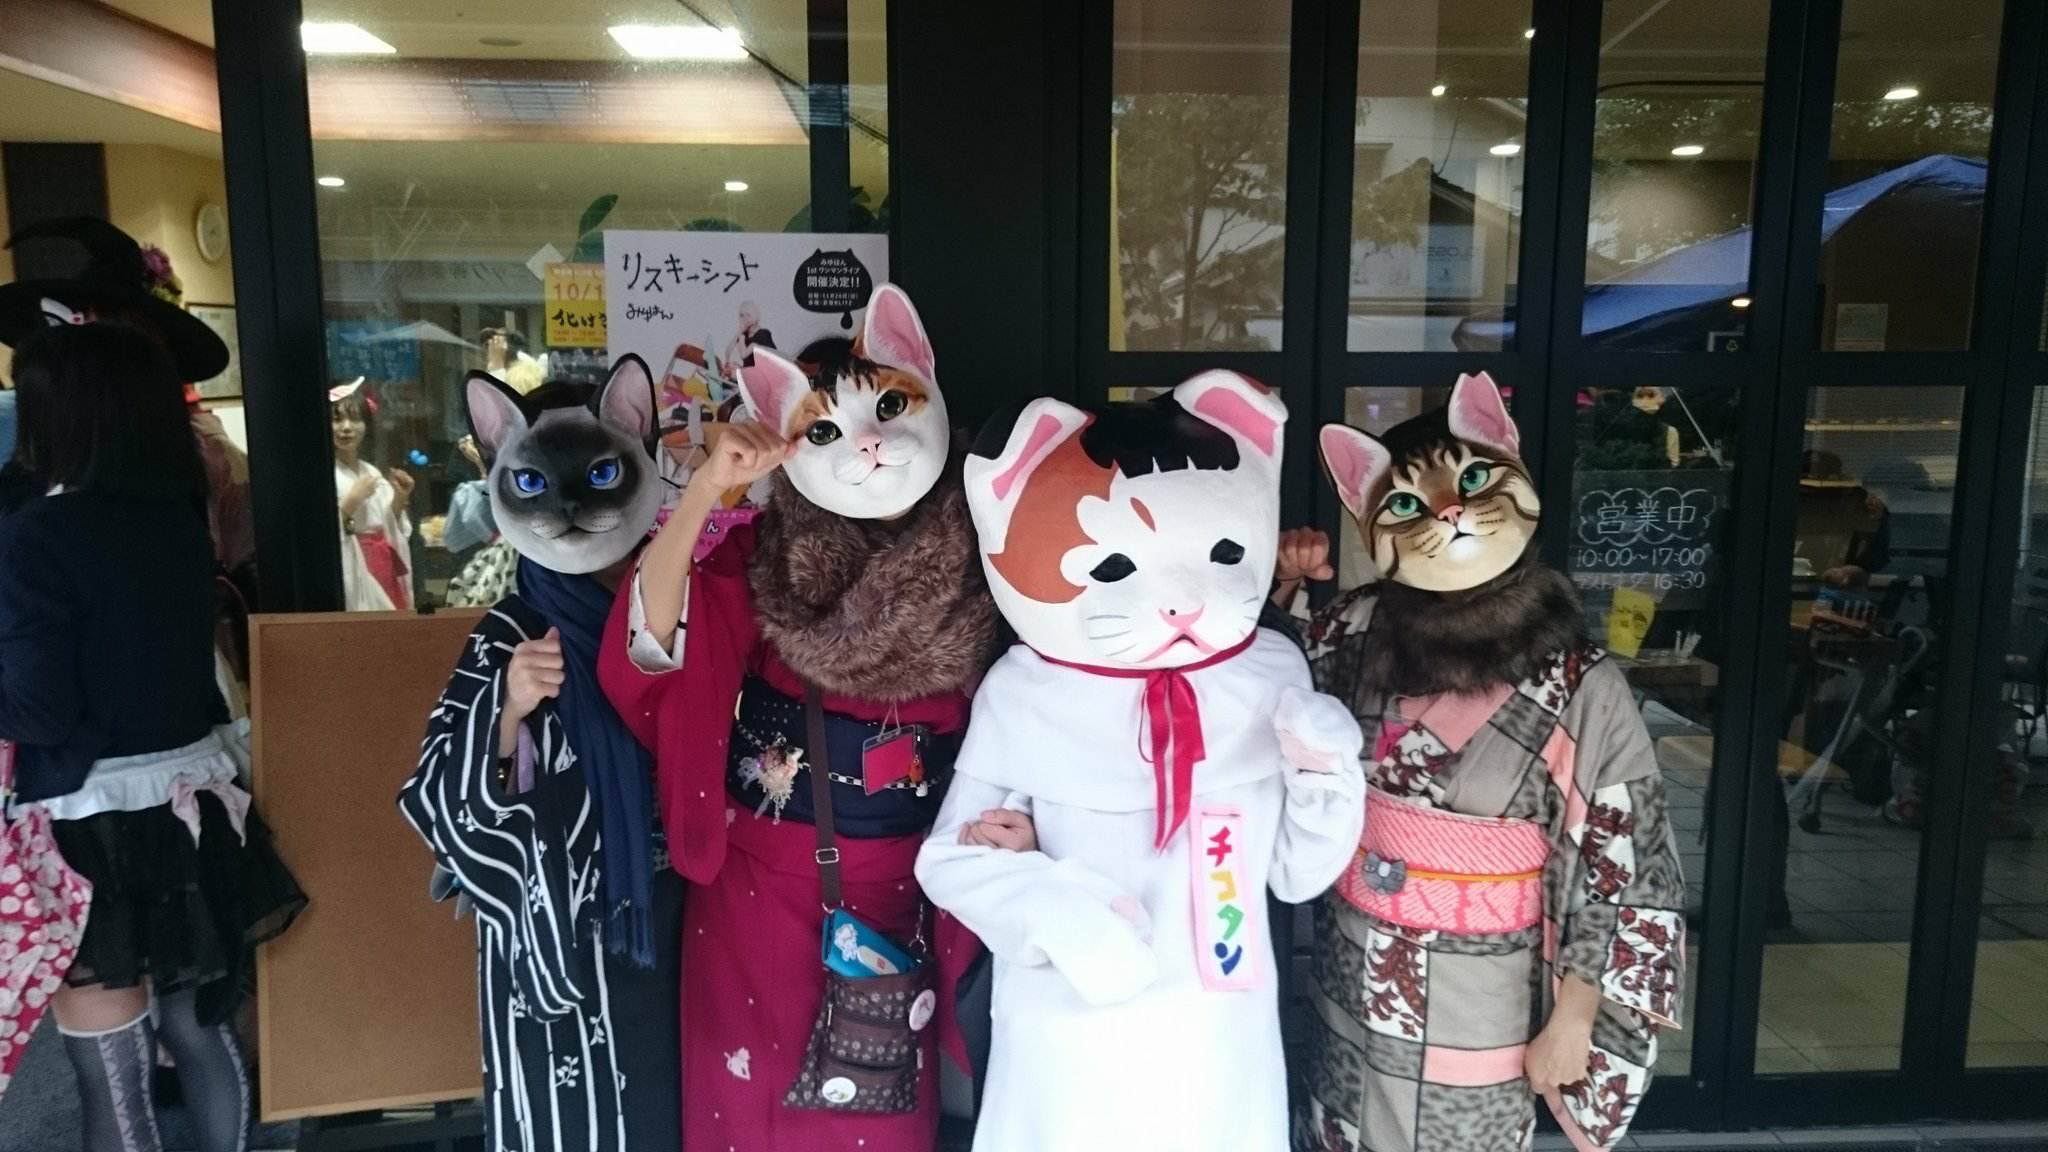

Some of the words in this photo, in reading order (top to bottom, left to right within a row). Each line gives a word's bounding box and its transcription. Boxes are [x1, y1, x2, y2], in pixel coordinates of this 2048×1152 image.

[622, 252, 759, 293] リスキーシフト
[1596, 499, 1697, 534] 営業中
[1654, 570, 1705, 590] 16:30
[1206, 825, 1245, 977] チコタン
